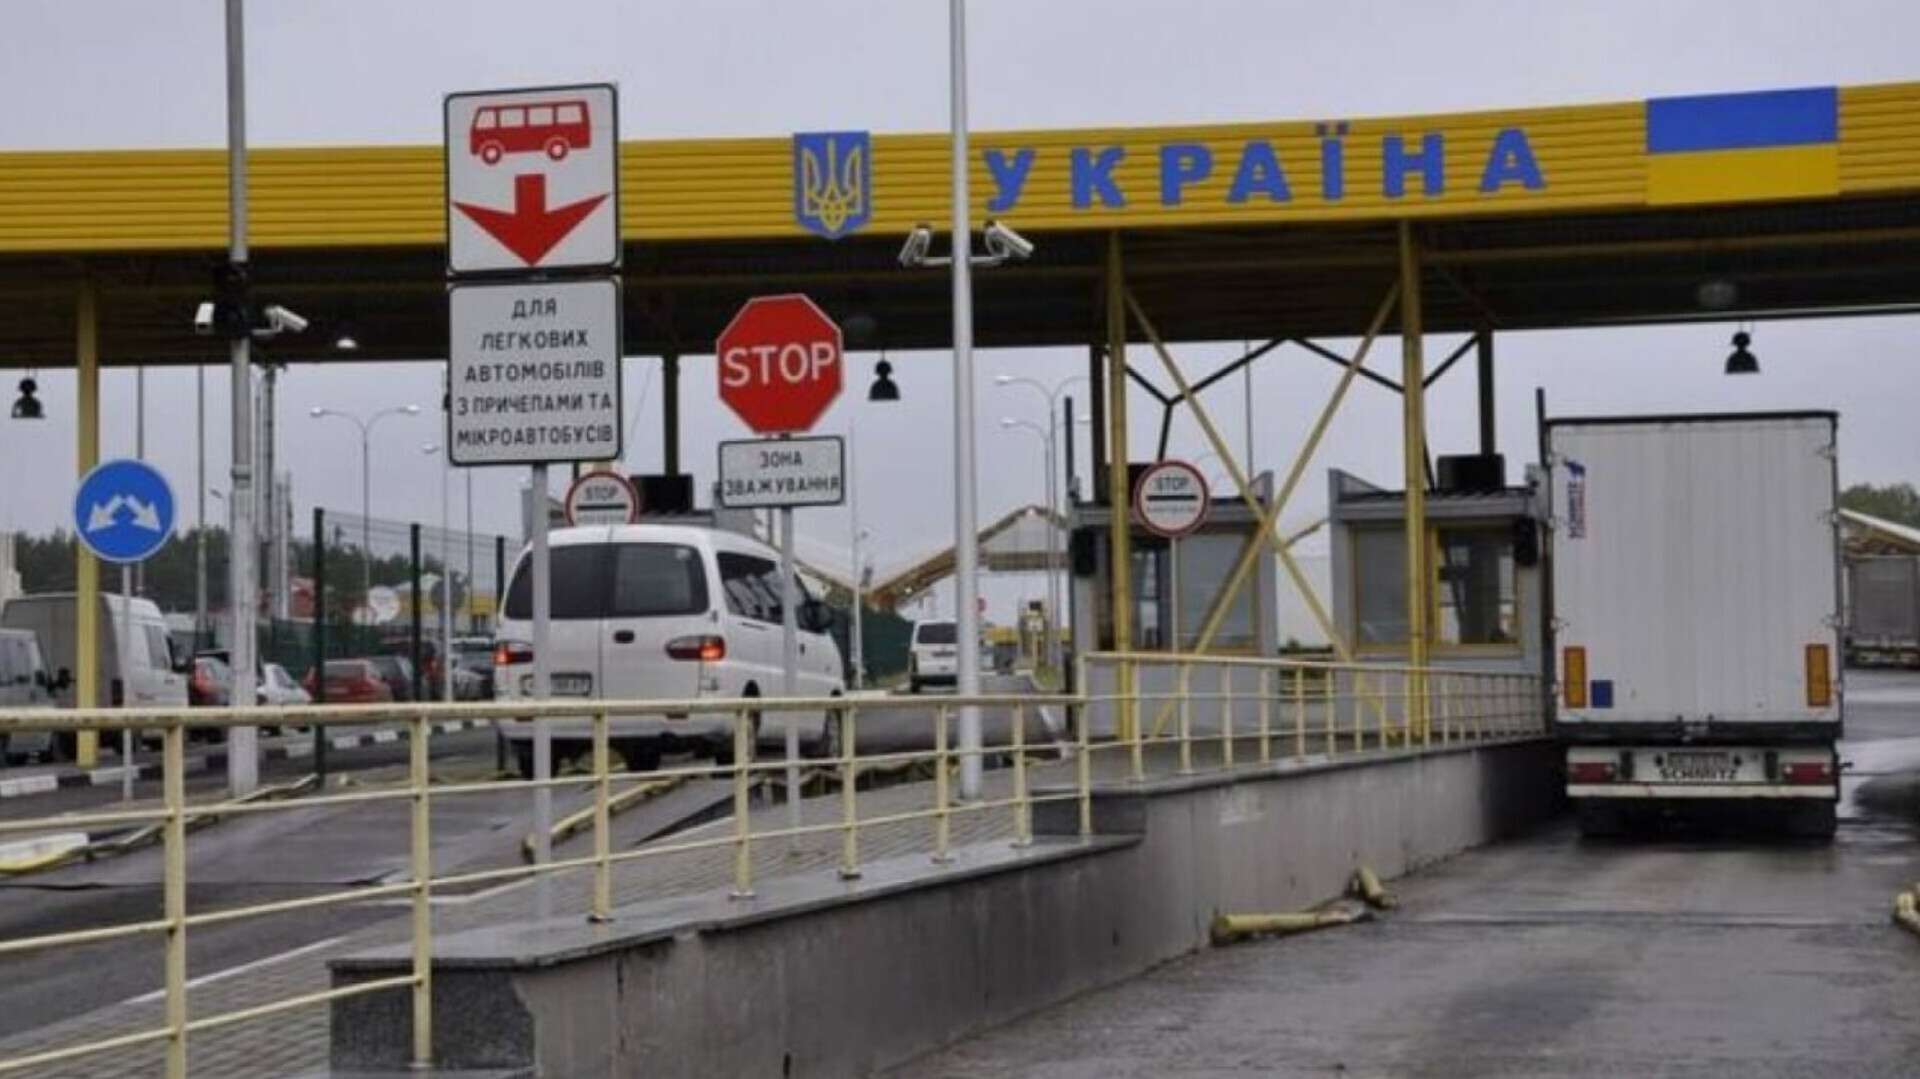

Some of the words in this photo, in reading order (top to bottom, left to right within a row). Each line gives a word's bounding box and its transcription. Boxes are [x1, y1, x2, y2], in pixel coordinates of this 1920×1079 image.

[982, 121, 1547, 211] УКРАЇНА
[511, 298, 557, 319] ДЛЯ
[481, 329, 589, 350] ЛЕГКОВИХ
[465, 361, 604, 383] АВТОМОБІЛІВ
[724, 342, 836, 387] STOP
[472, 393, 584, 415] ПРИЧЕПАМИ
[588, 392, 612, 411] ТА
[457, 425, 613, 447] МІКРОАВТОБУСІВ
[760, 450, 802, 468] ЗОНА
[585, 484, 618, 501] STOP
[725, 476, 840, 497] ЗВАЖУВАННЯ
[1158, 475, 1190, 491] STOP
